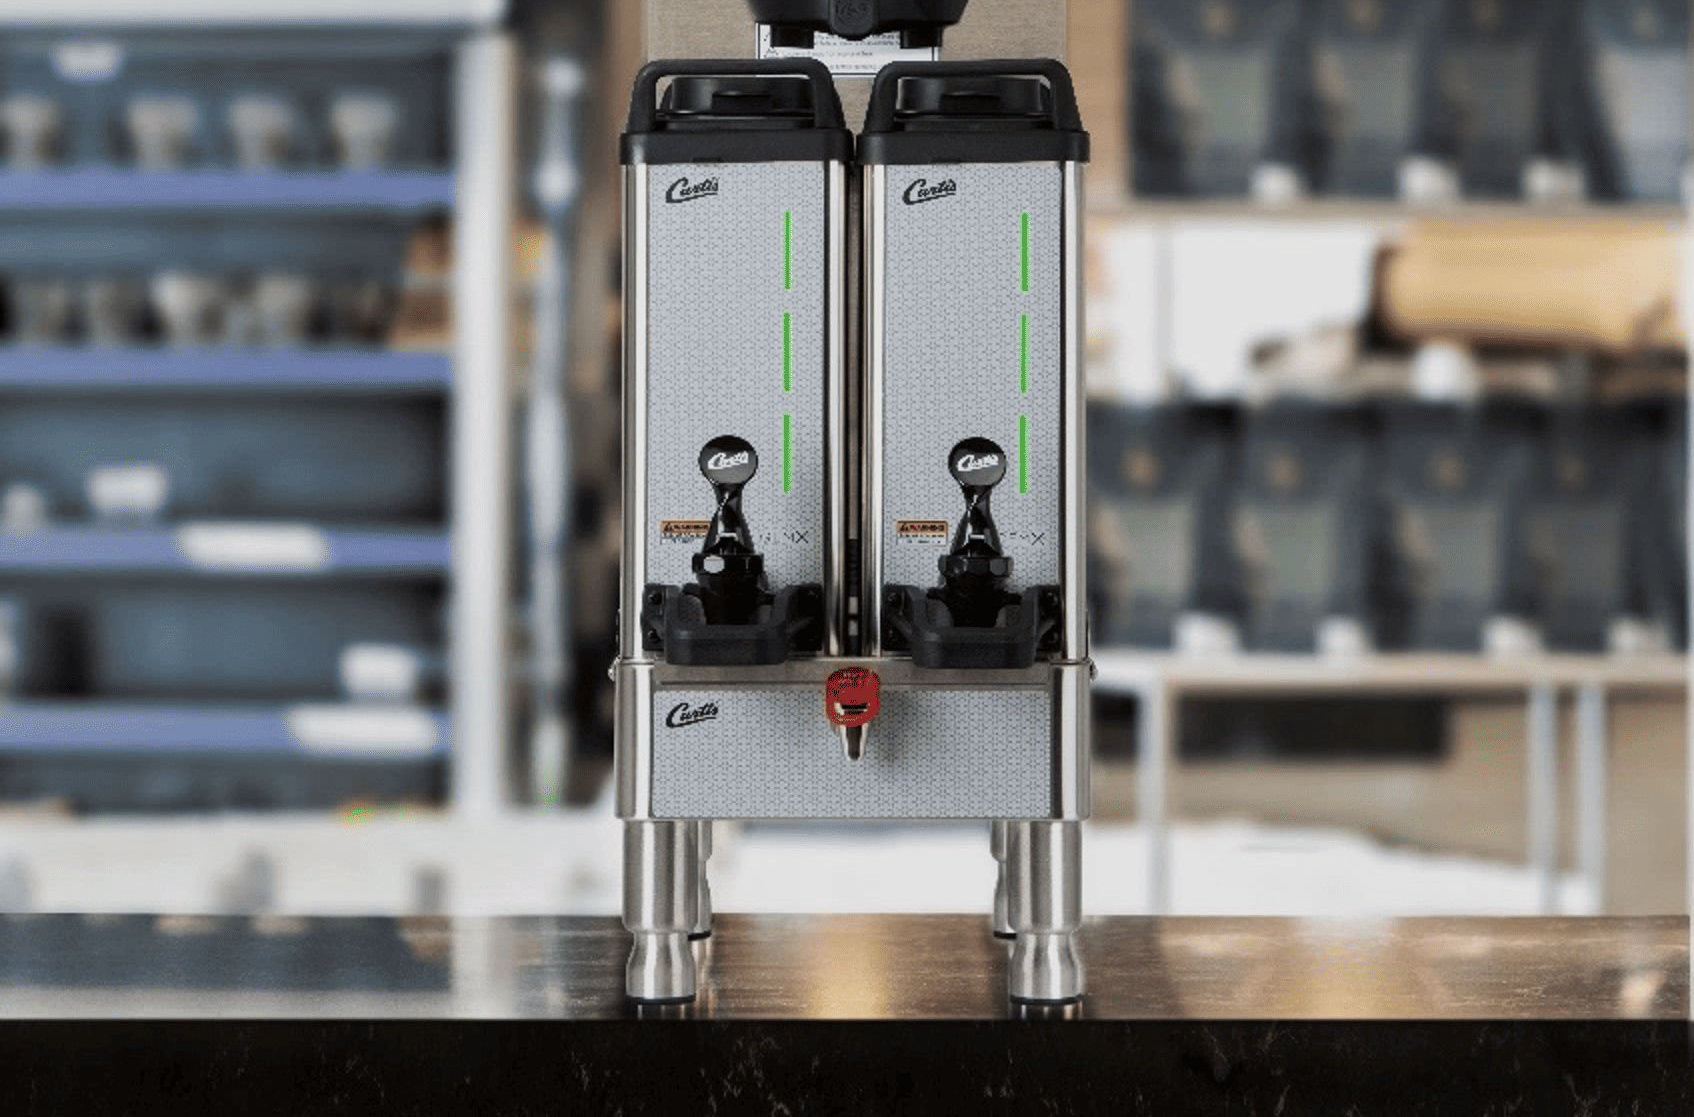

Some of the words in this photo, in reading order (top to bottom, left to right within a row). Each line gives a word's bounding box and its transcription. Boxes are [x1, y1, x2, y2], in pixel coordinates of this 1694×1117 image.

[665, 177, 719, 203] Curtis
[902, 178, 957, 205] Curtis
[666, 701, 718, 728] Curtis
